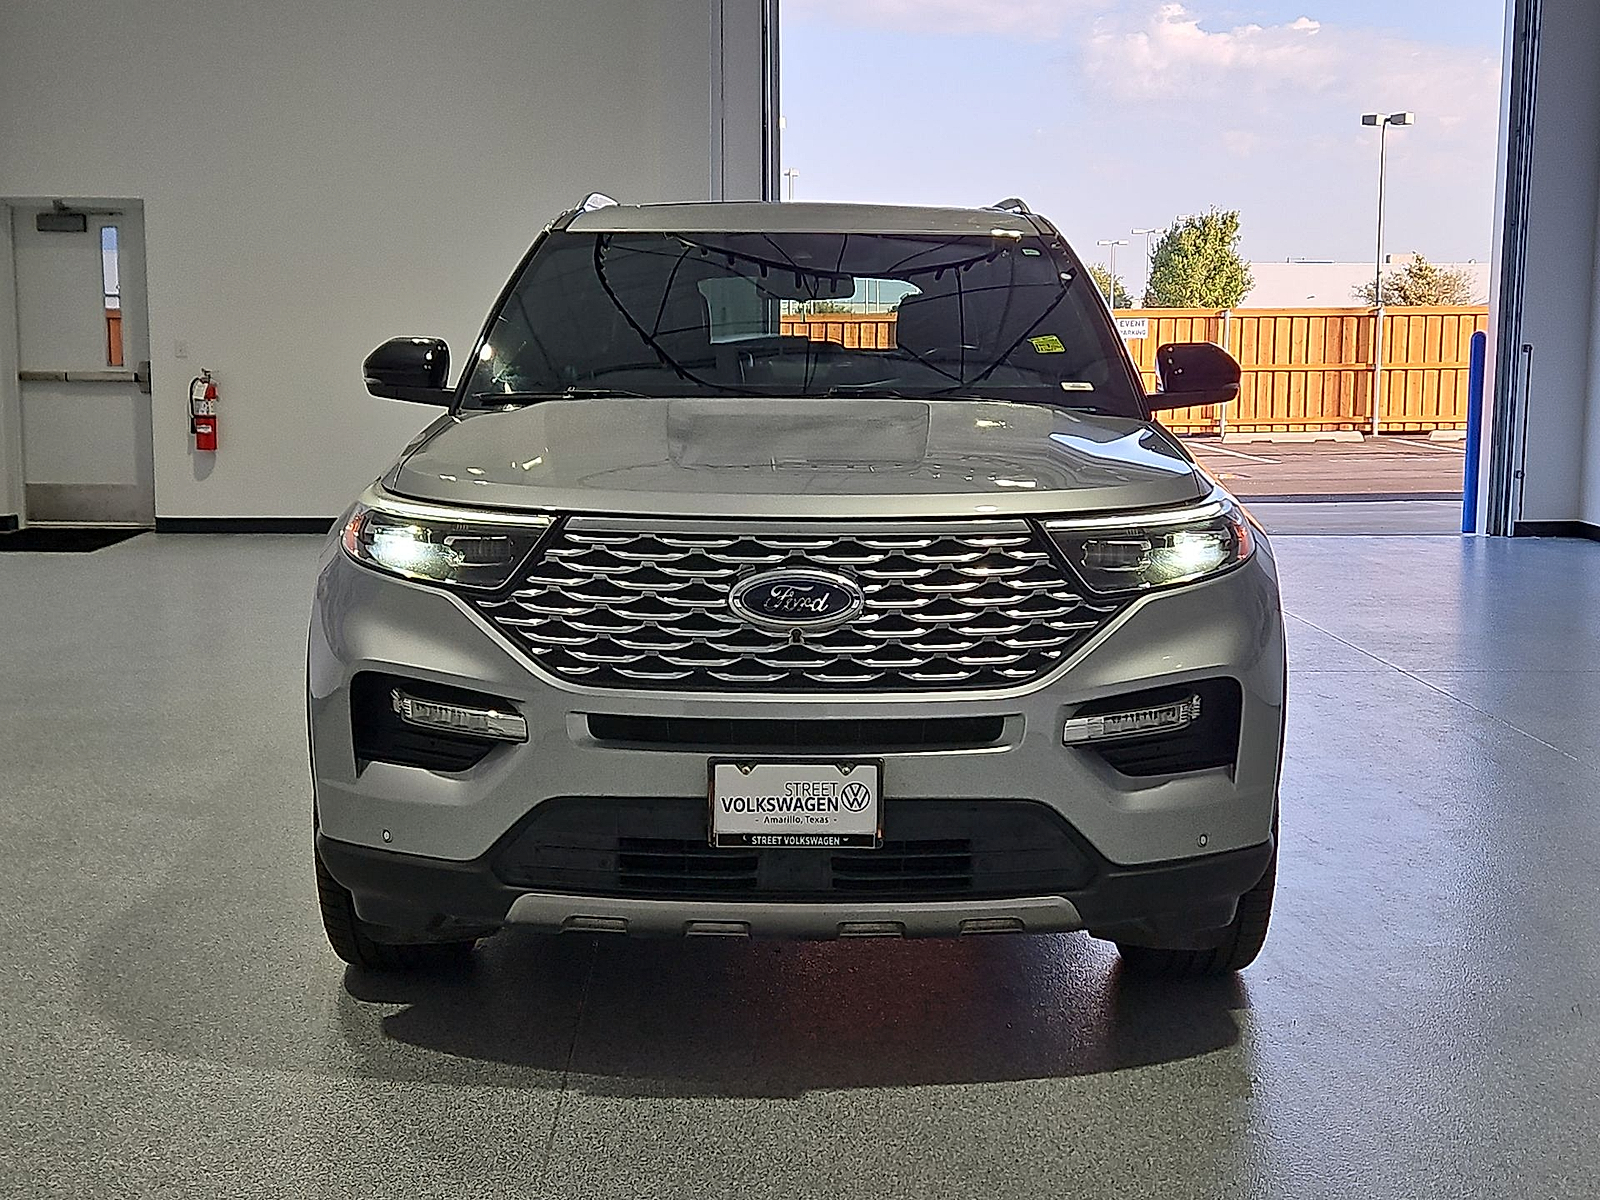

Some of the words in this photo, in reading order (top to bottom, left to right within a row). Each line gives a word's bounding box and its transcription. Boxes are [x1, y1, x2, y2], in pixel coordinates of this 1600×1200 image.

[1119, 320, 1146, 328] EVENT
[763, 585, 830, 612] Ford
[785, 782, 839, 797] STREET
[721, 797, 839, 812] VOLKSWAGEN
[763, 816, 804, 825] Amarillo,
[806, 816, 829, 824] Texas
[752, 836, 782, 845] STREET
[783, 836, 840, 846] VOLKSWAGEN
